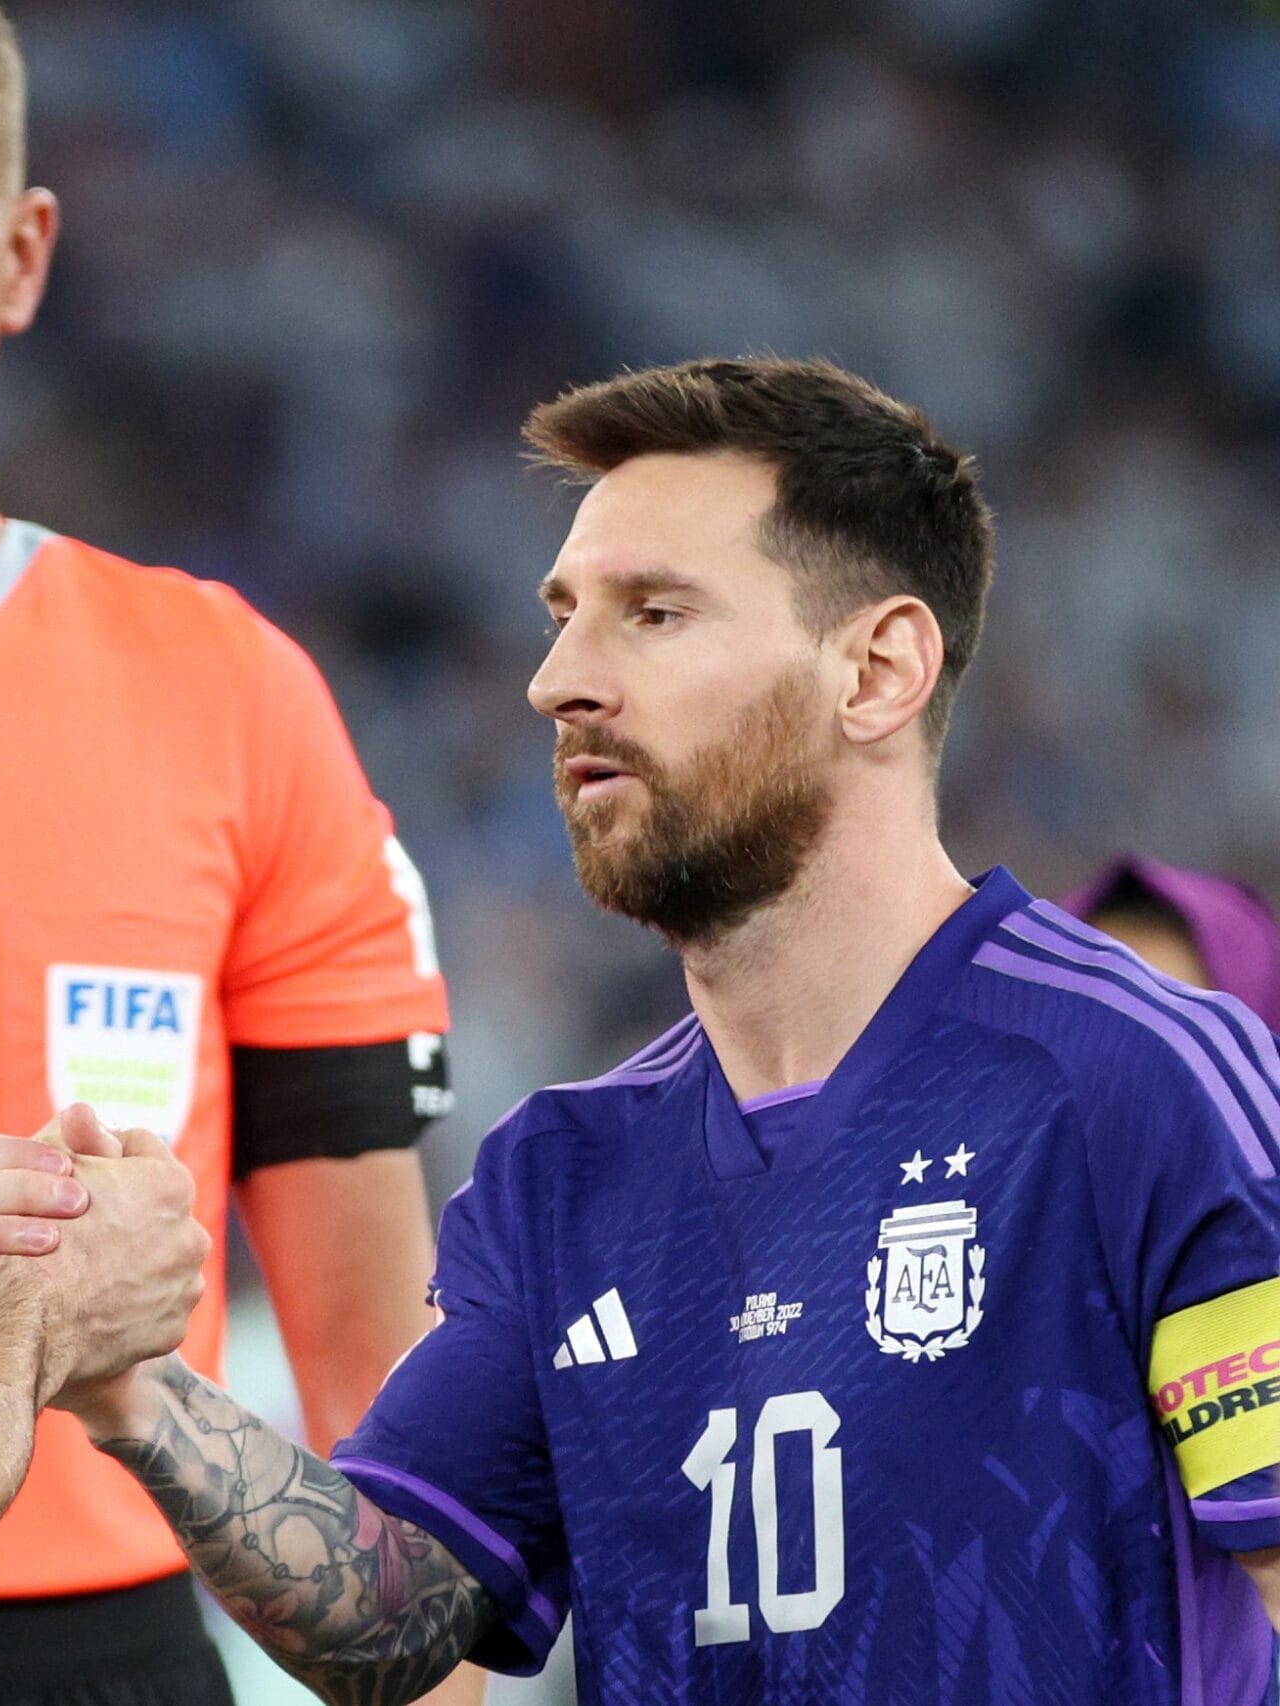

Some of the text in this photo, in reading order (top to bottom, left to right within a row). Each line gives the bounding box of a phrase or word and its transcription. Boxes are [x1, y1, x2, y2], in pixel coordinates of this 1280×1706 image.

[66, 983, 180, 1033] FIFA
[892, 1244, 955, 1313] AFA
[745, 1292, 777, 1311] POLAND
[776, 1302, 803, 1320] 2022
[766, 1319, 787, 1336] 974
[681, 1390, 845, 1647] 10
